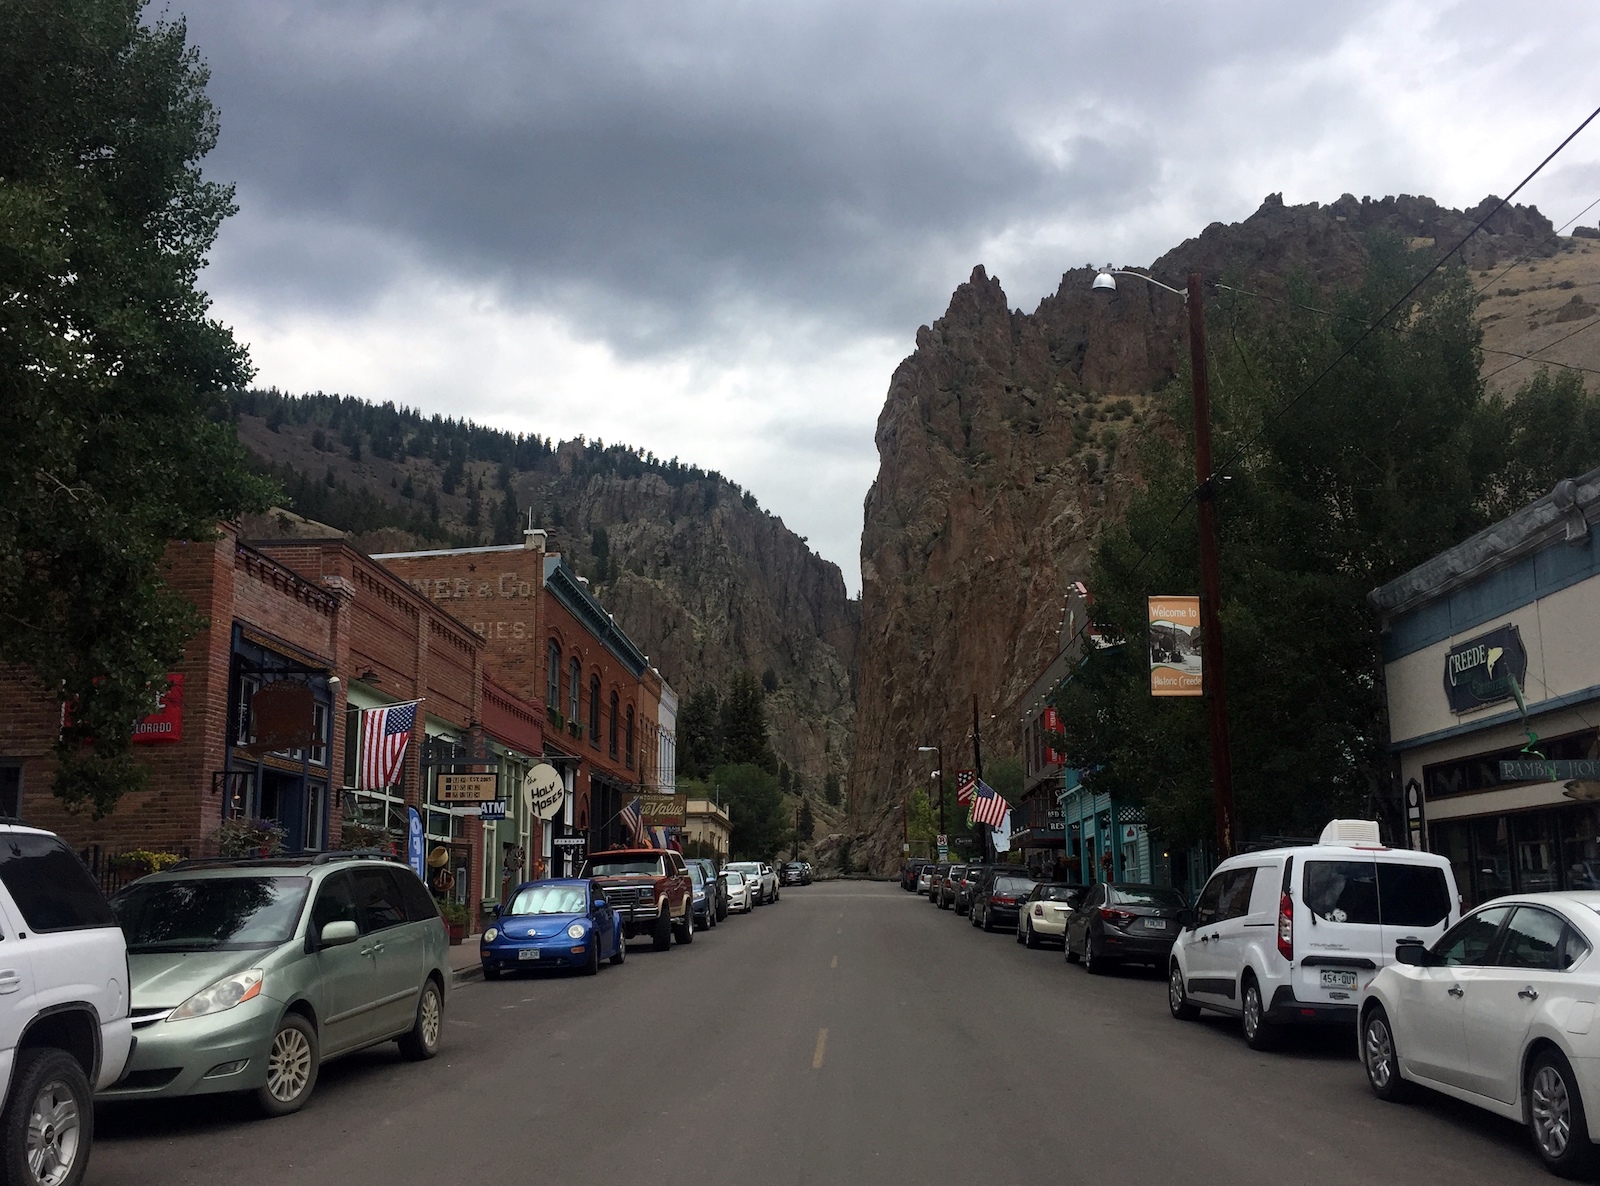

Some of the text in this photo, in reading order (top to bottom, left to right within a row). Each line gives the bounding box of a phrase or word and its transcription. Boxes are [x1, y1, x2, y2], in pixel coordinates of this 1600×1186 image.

[477, 582, 493, 596] &
[1151, 606, 1196, 617] Welcome to
[474, 622, 532, 639] RIES.
[1449, 644, 1486, 687] CREEDE
[1153, 676, 1177, 688] Historic
[135, 722, 172, 733] LORADO
[1568, 761, 1600, 778] HOU
[531, 781, 555, 799] HOLY
[481, 802, 505, 814] ATM
[532, 788, 562, 817] MOSES
[644, 801, 684, 816] Value
